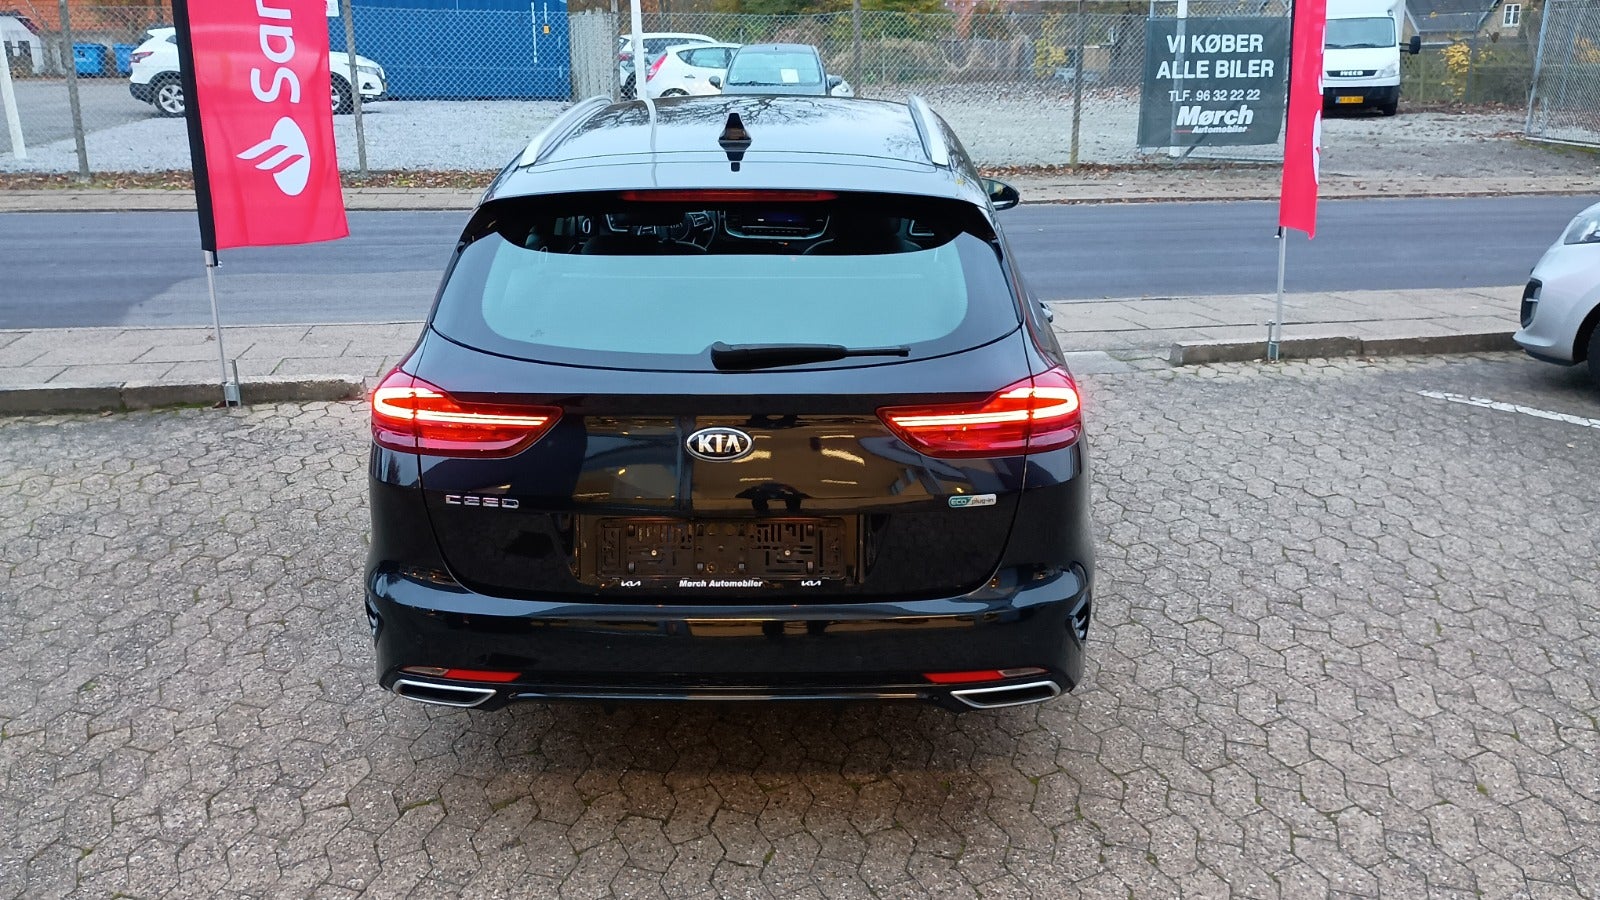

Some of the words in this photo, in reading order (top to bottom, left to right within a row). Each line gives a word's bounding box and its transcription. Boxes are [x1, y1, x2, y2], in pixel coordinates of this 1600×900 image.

[1166, 34, 1186, 53] VI
[1191, 34, 1264, 53] KØBER
[1156, 60, 1210, 79] ALLE
[1215, 59, 1275, 78] BILER
[1168, 90, 1193, 102] TLF.
[1196, 89, 1211, 101] 96
[1213, 89, 1228, 101] 32
[1230, 89, 1245, 101] 22
[1246, 89, 1261, 101] 22
[1176, 104, 1254, 126] Mørch
[1191, 125, 1248, 134] Automobiler
[697, 433, 742, 453] KIA
[708, 580, 763, 588] Automobiler
